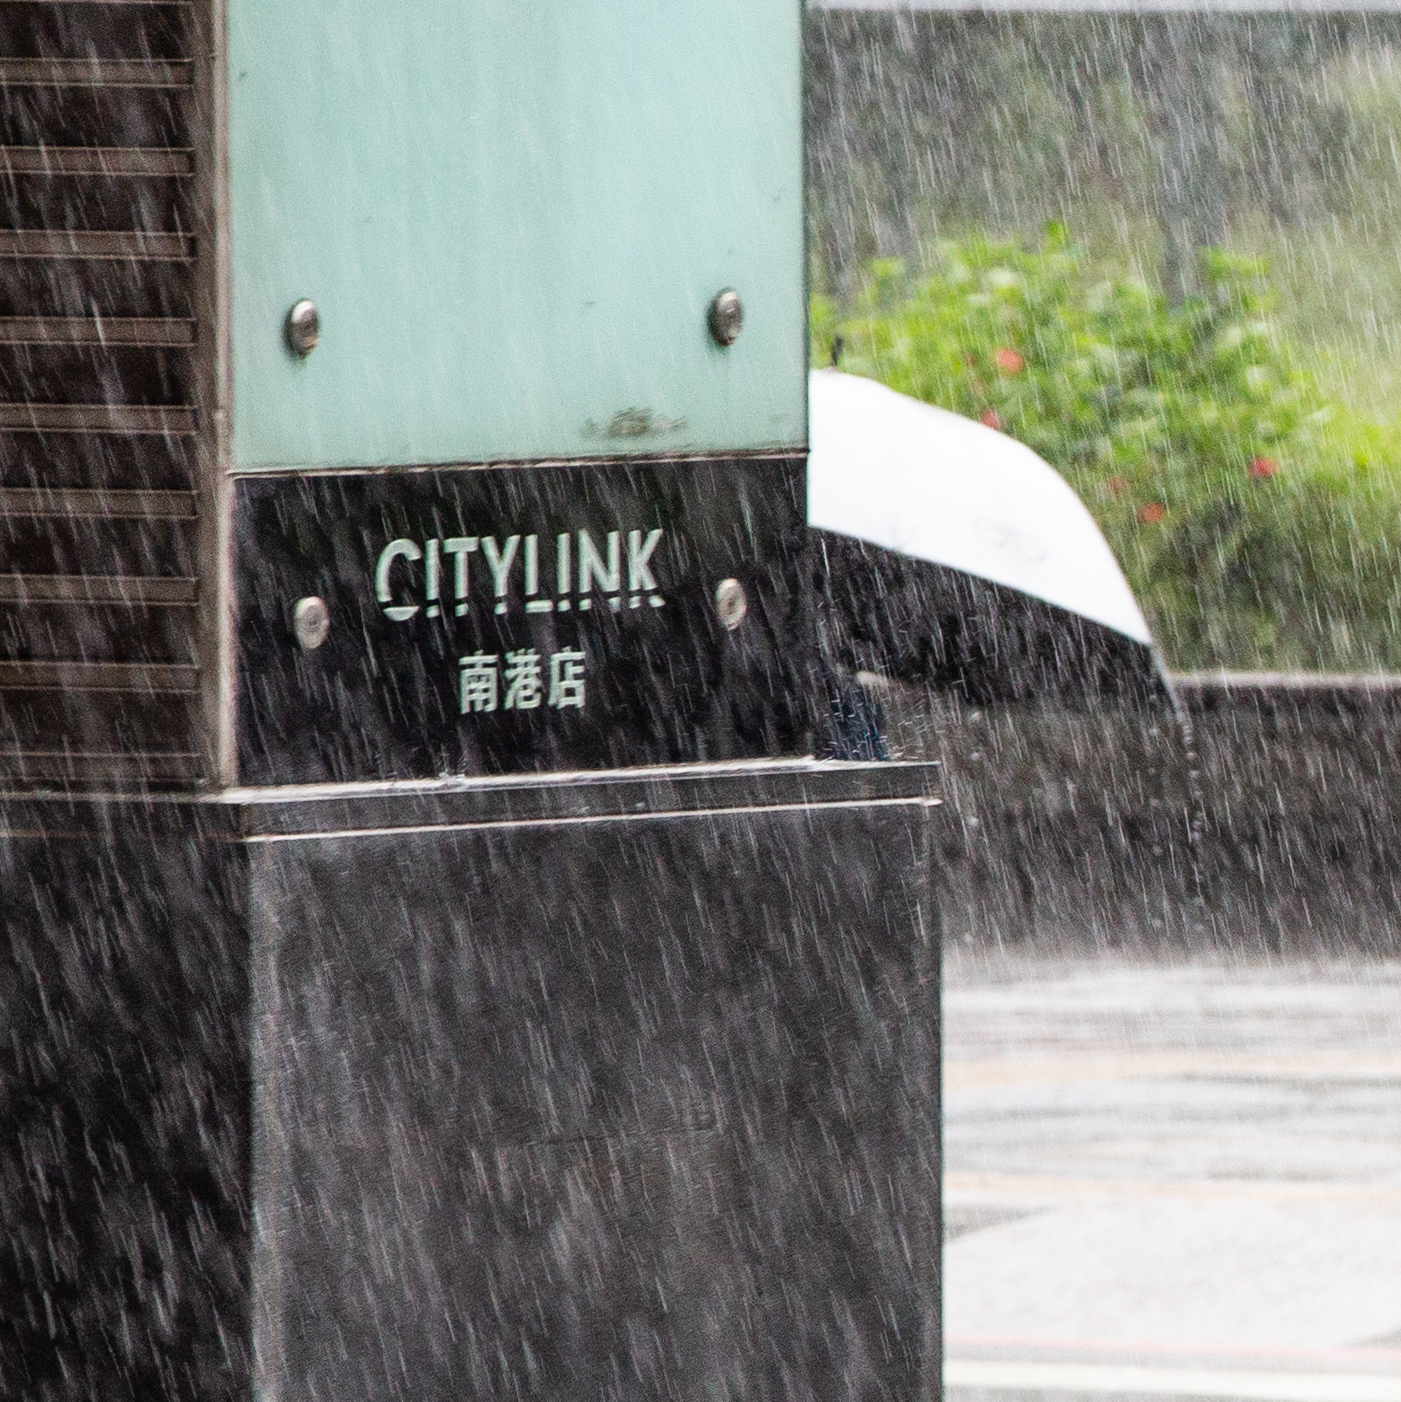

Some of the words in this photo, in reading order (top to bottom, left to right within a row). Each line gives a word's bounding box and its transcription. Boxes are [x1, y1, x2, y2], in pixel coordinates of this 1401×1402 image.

[374, 528, 666, 622] CITYLINK
[459, 646, 587, 715] 南港店
